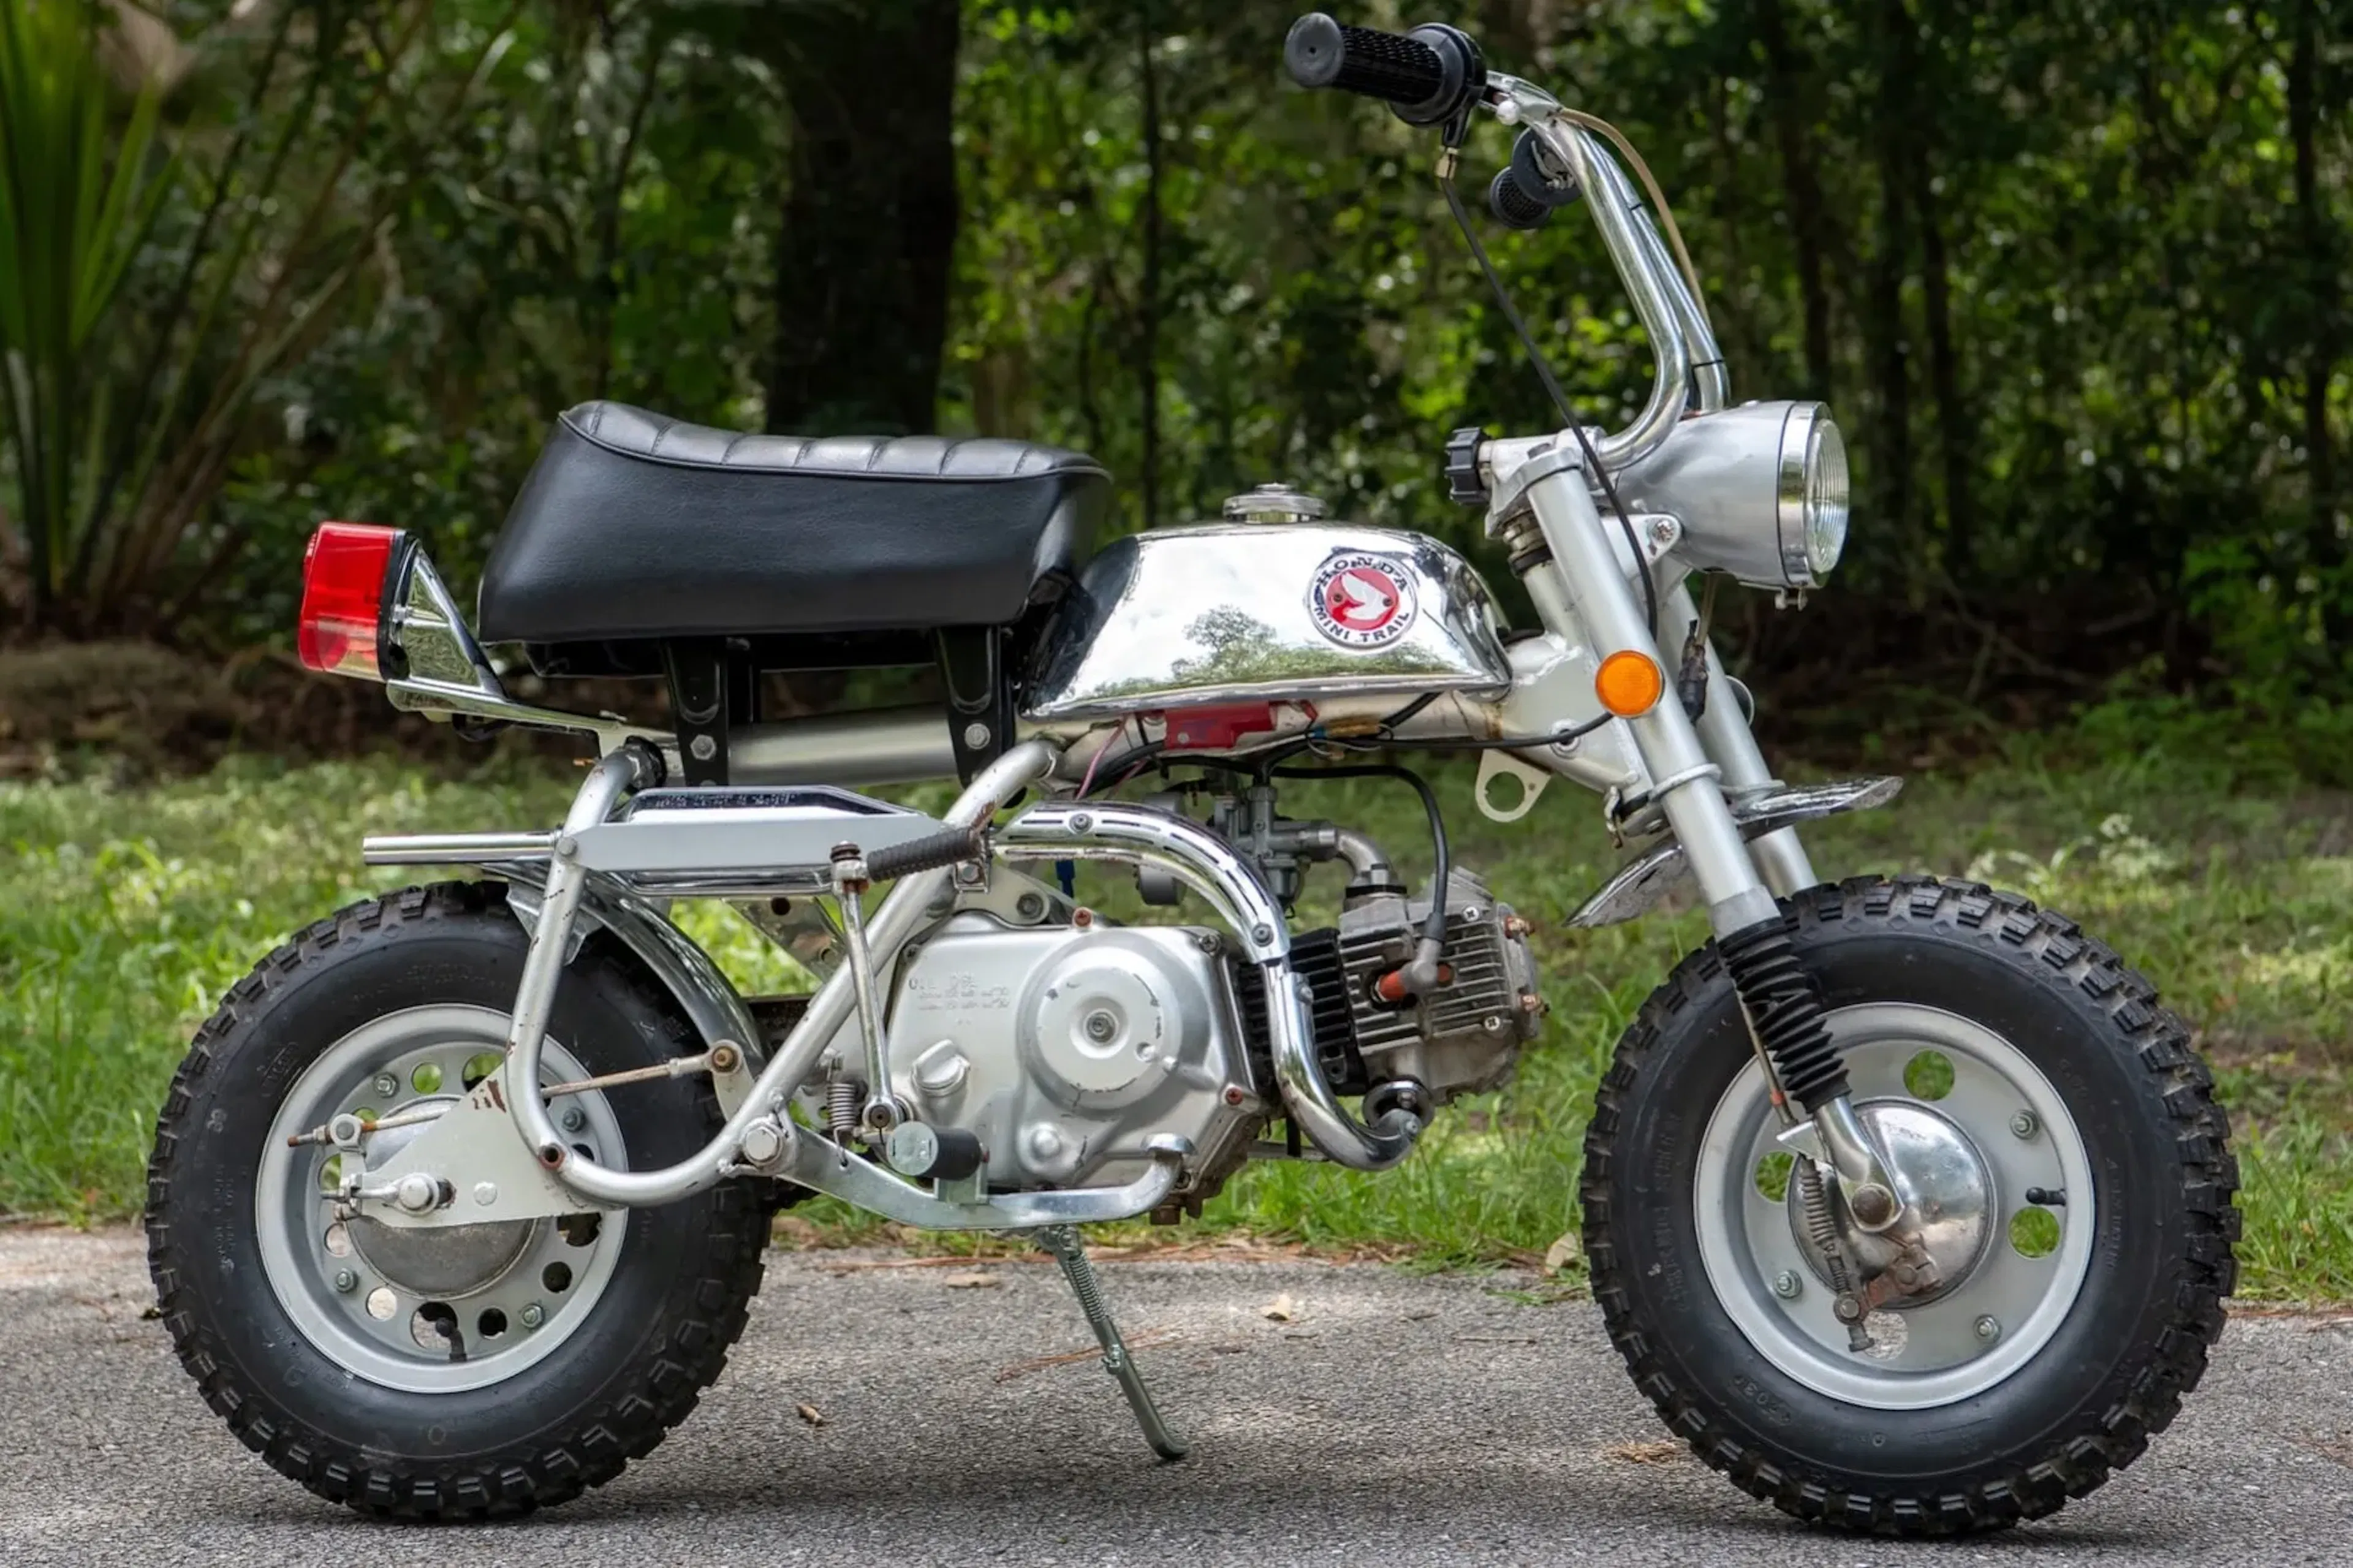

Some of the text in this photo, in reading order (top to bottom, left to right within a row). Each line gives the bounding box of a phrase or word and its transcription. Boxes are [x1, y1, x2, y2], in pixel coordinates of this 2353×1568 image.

[1317, 557, 1408, 592] HONDA
[1314, 607, 1409, 642] MINI TRAIL
